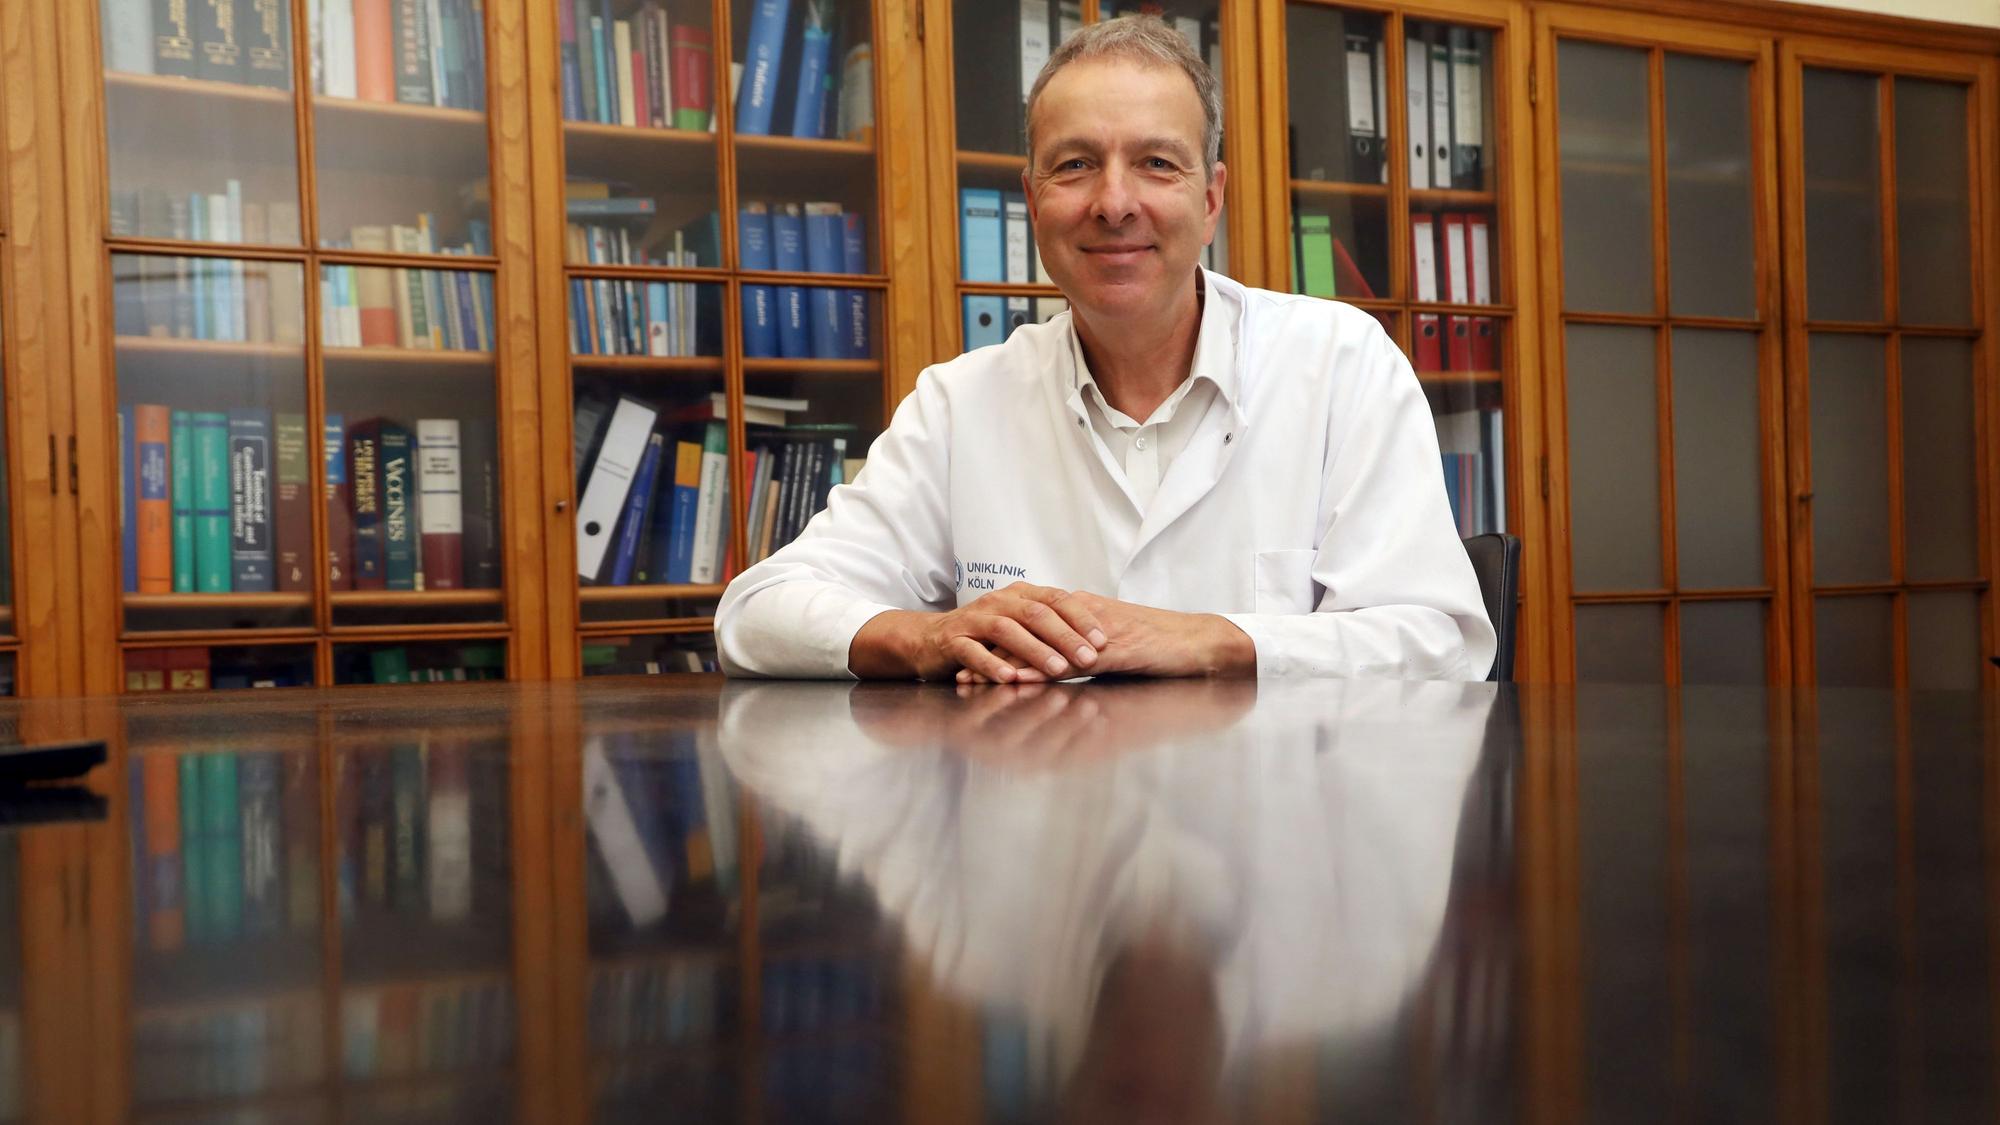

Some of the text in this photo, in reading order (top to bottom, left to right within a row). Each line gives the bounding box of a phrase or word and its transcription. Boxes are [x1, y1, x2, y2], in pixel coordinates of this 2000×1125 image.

[401, 0, 420, 75] ATRICS
[852, 295, 865, 348] Pädiatrie
[385, 457, 406, 542] VACCINES
[967, 562, 1027, 578] UNIKLINIK
[967, 576, 995, 589] KÖLN
